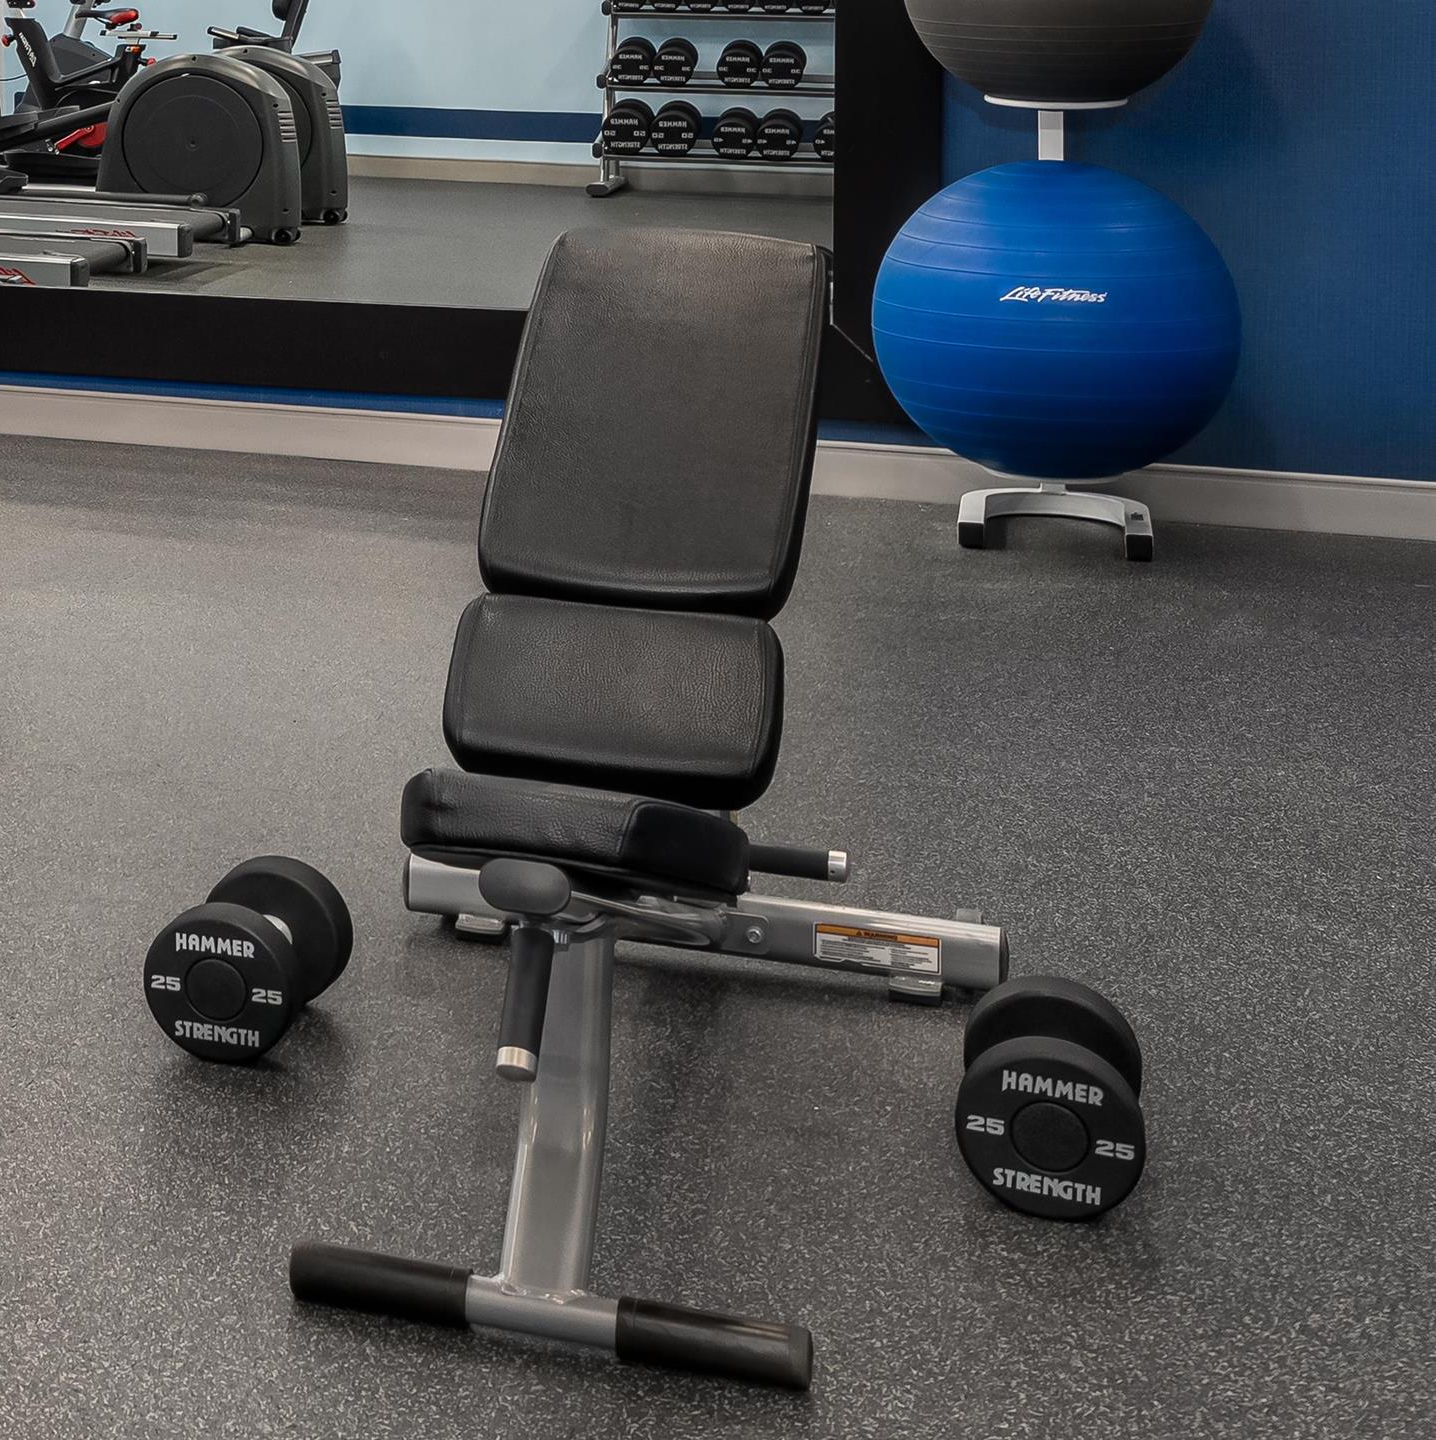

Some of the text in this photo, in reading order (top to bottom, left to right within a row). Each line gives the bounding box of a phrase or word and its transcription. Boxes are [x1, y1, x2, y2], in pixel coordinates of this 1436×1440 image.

[175, 932, 255, 959] HAMMER
[151, 974, 282, 1005] 25 25
[174, 1020, 259, 1047] STRENGTH
[1001, 1069, 1104, 1106] HAMMER
[965, 1114, 1135, 1161] 25 25
[992, 1167, 1102, 1206] STRENGTH
